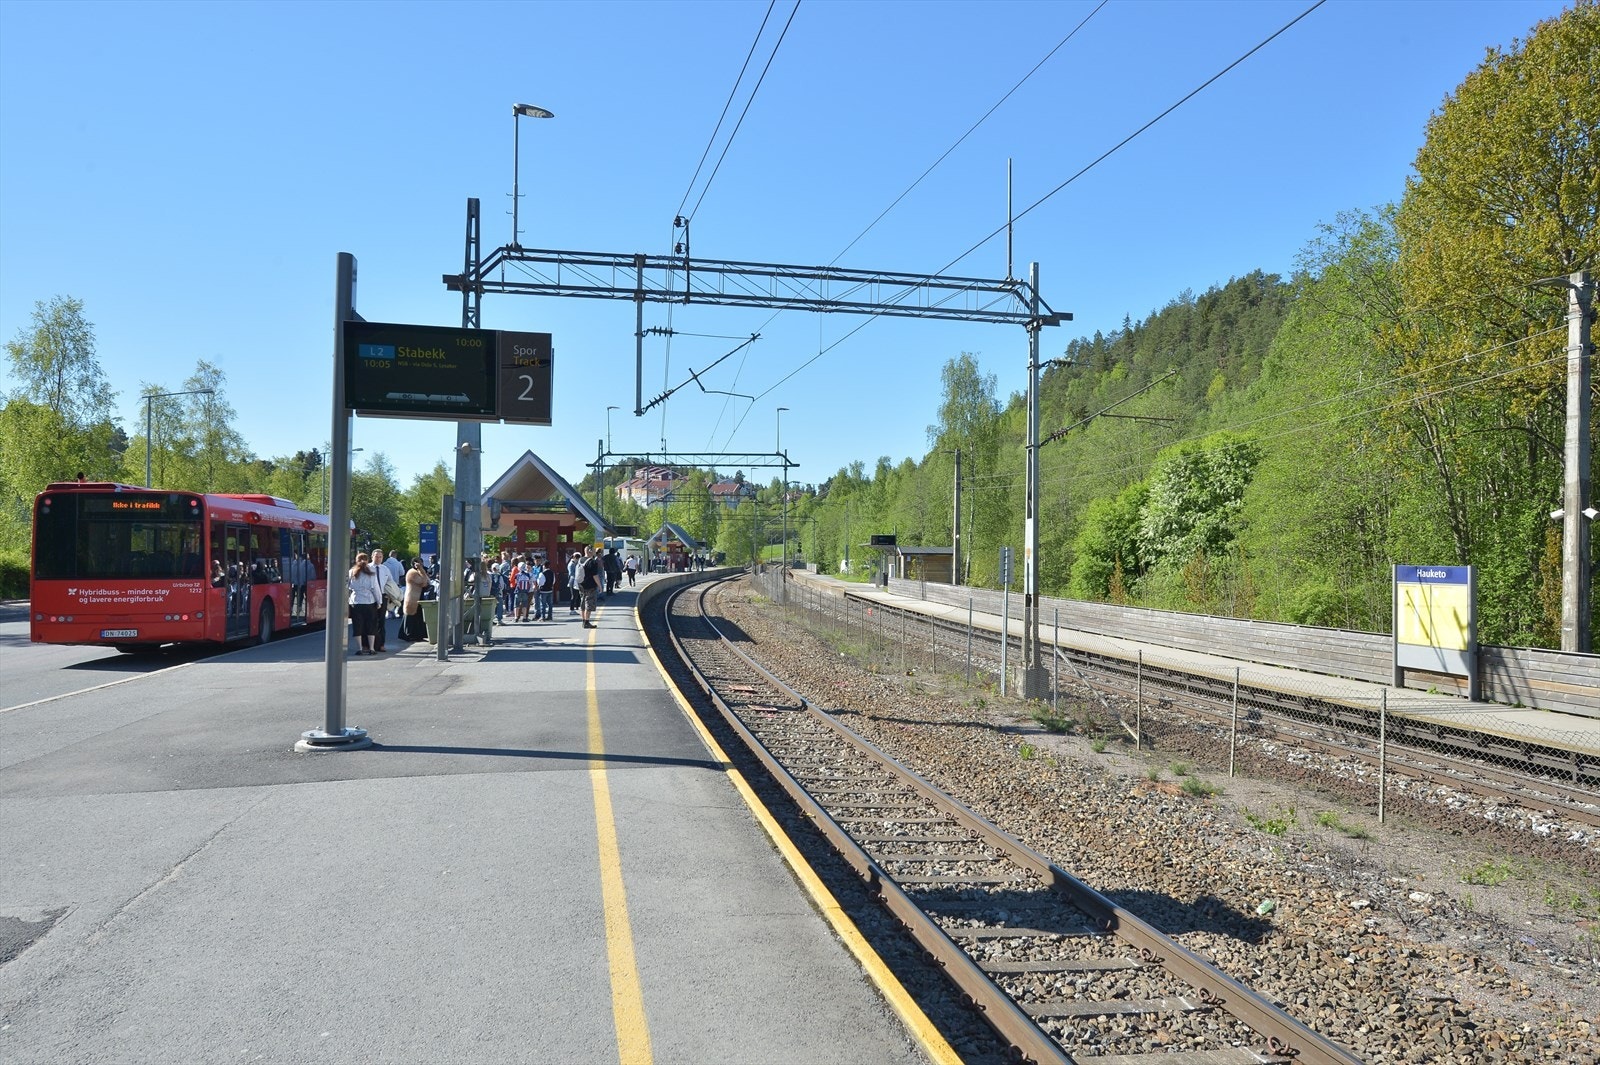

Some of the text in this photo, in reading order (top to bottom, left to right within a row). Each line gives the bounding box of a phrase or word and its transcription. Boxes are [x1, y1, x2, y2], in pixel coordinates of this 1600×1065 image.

[455, 338, 482, 347] 10:00
[370, 347, 384, 357] L 2
[398, 347, 446, 360] Stabekk
[513, 344, 537, 356] Spor
[364, 359, 391, 369] 10:05
[513, 356, 541, 367] Track
[518, 374, 534, 400] 2
[1416, 569, 1447, 578] Hauketo
[79, 588, 120, 596] Hybridbuss
[127, 588, 154, 596] mindre
[154, 588, 170, 596] støy
[79, 597, 88, 605] og
[113, 595, 164, 604] energiforbruk
